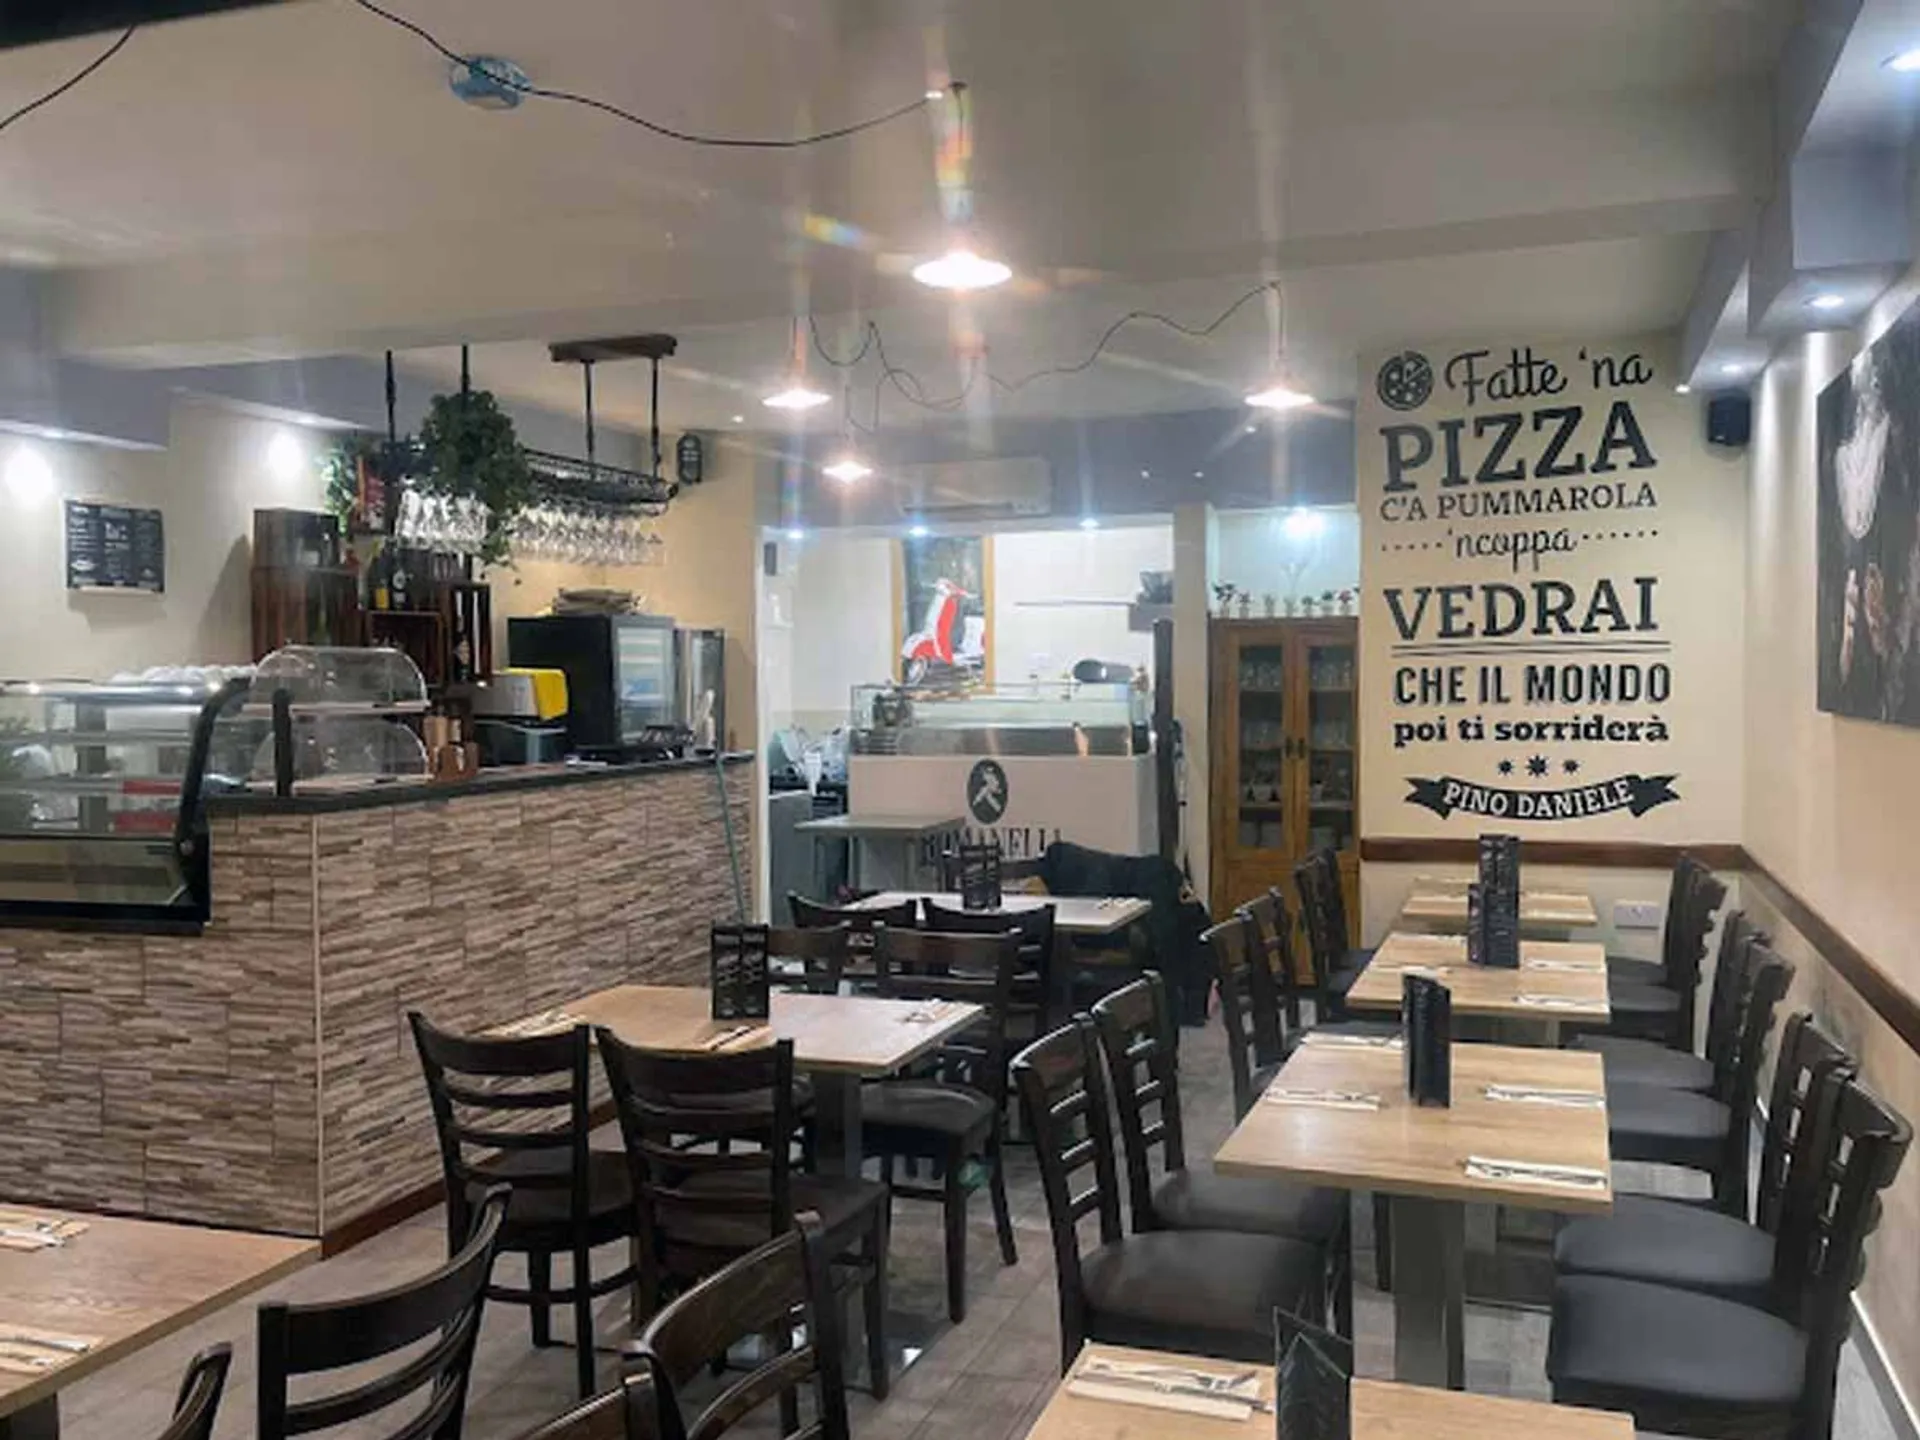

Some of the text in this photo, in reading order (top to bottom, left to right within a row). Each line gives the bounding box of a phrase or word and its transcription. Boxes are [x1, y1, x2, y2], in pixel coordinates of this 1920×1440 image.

[1444, 347, 1567, 406] Fatte
[1379, 401, 1657, 493] PIZZA
[1380, 482, 1658, 521] C'A PUMMAROLA
[1383, 577, 1658, 640] VEDRAI
[1394, 662, 1671, 705] CHE IL MONDO
[1394, 714, 1670, 748] poi ti sorriderà
[1442, 780, 1635, 818] PINO DANIELE
